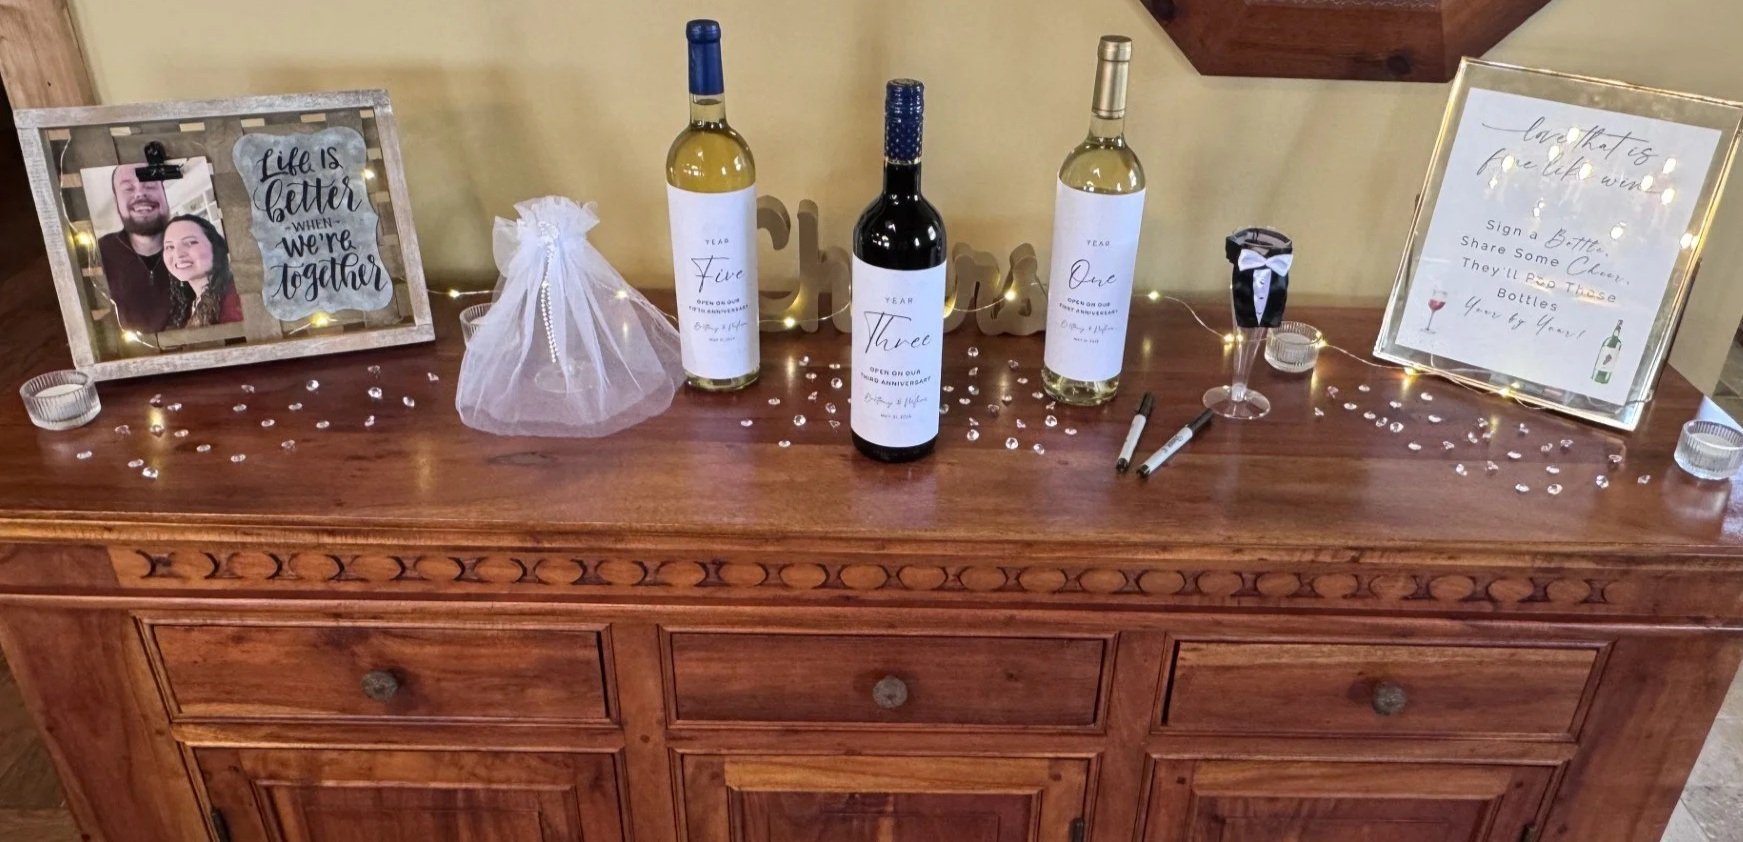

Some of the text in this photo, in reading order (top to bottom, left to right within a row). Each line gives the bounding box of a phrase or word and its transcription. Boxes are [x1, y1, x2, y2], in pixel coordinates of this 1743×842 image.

[1482, 116, 1659, 166] love that is
[255, 146, 315, 183] Life
[253, 176, 362, 223] better
[275, 229, 356, 258] we're
[1486, 219, 1522, 237] Sign
[1529, 231, 1538, 240] a
[1460, 235, 1506, 254] Share
[1514, 248, 1559, 267] Some
[270, 252, 388, 302] together
[690, 255, 743, 293] Five
[1069, 259, 1117, 289] One
[1462, 257, 1617, 303] They'll Pop Those
[707, 304, 749, 315] ANNIVERSARY
[885, 297, 913, 305] YEAR
[1059, 302, 1075, 312] FIRST
[1067, 297, 1085, 306] OPEN
[1464, 295, 1501, 319] Year
[1508, 312, 1525, 330] by
[1497, 288, 1558, 312] Bottles
[863, 311, 931, 354] Three
[861, 372, 931, 387] THIRD ANNIVERSARY
[870, 366, 889, 376] OPEN
[892, 369, 903, 377] ON
